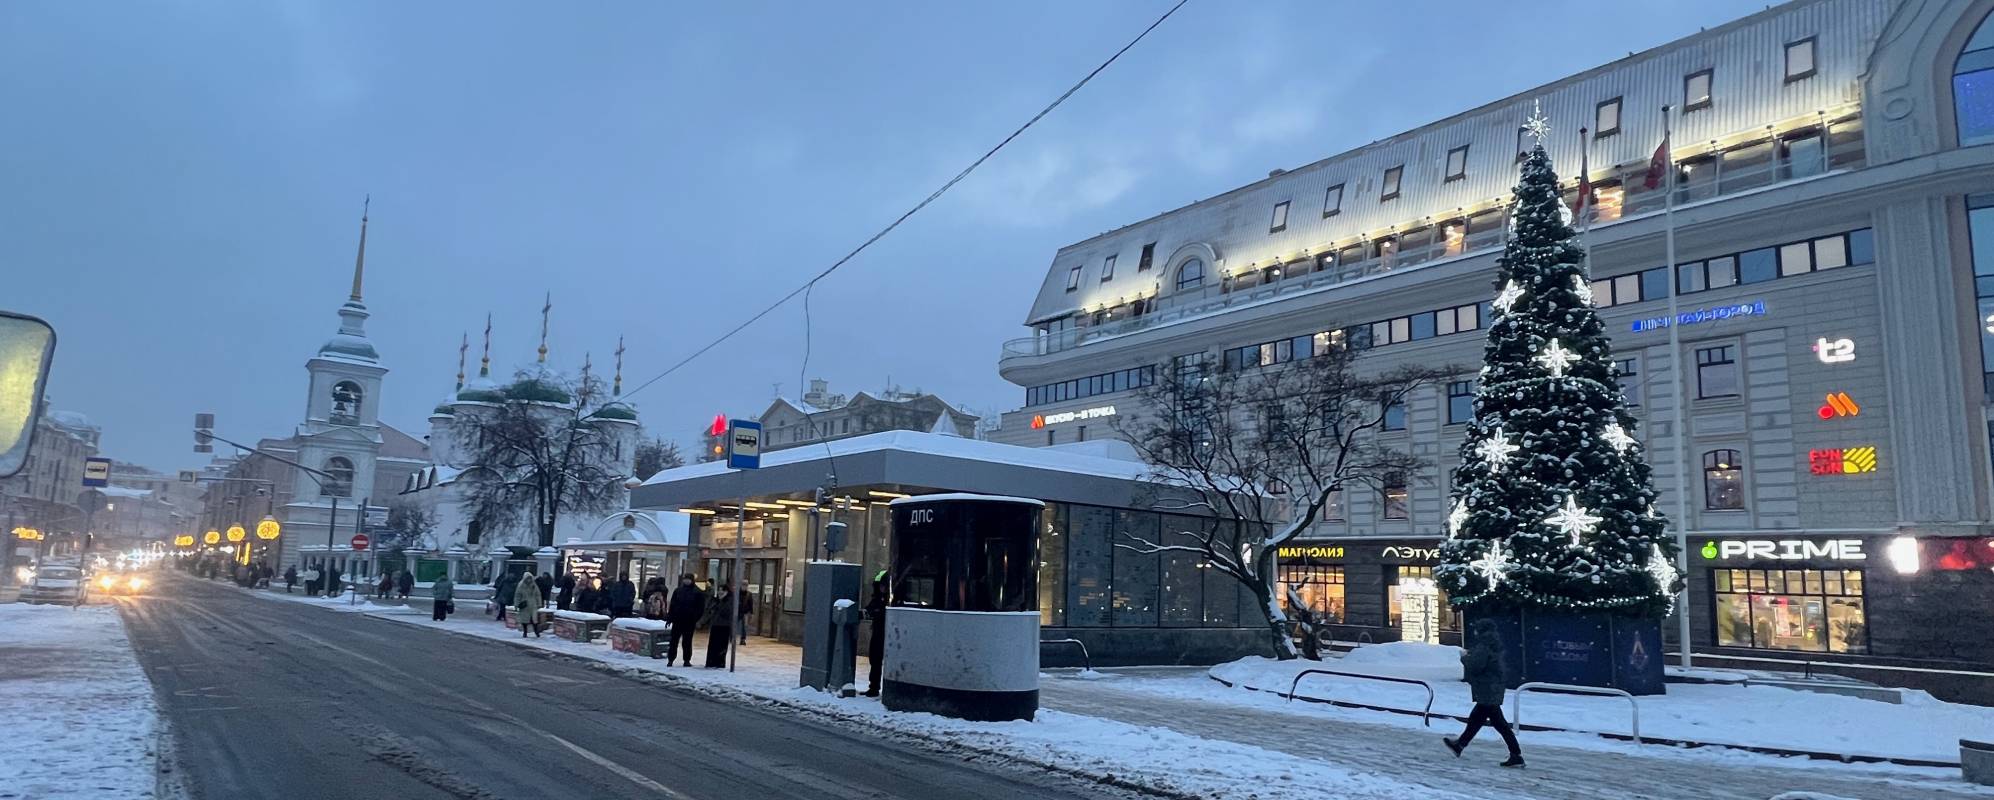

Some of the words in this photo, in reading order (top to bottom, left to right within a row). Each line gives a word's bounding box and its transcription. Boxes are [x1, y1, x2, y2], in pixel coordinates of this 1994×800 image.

[910, 509, 934, 526] ДПС
[1382, 546, 1440, 561] Л'Этуа
[1721, 539, 1867, 561] PRIME
